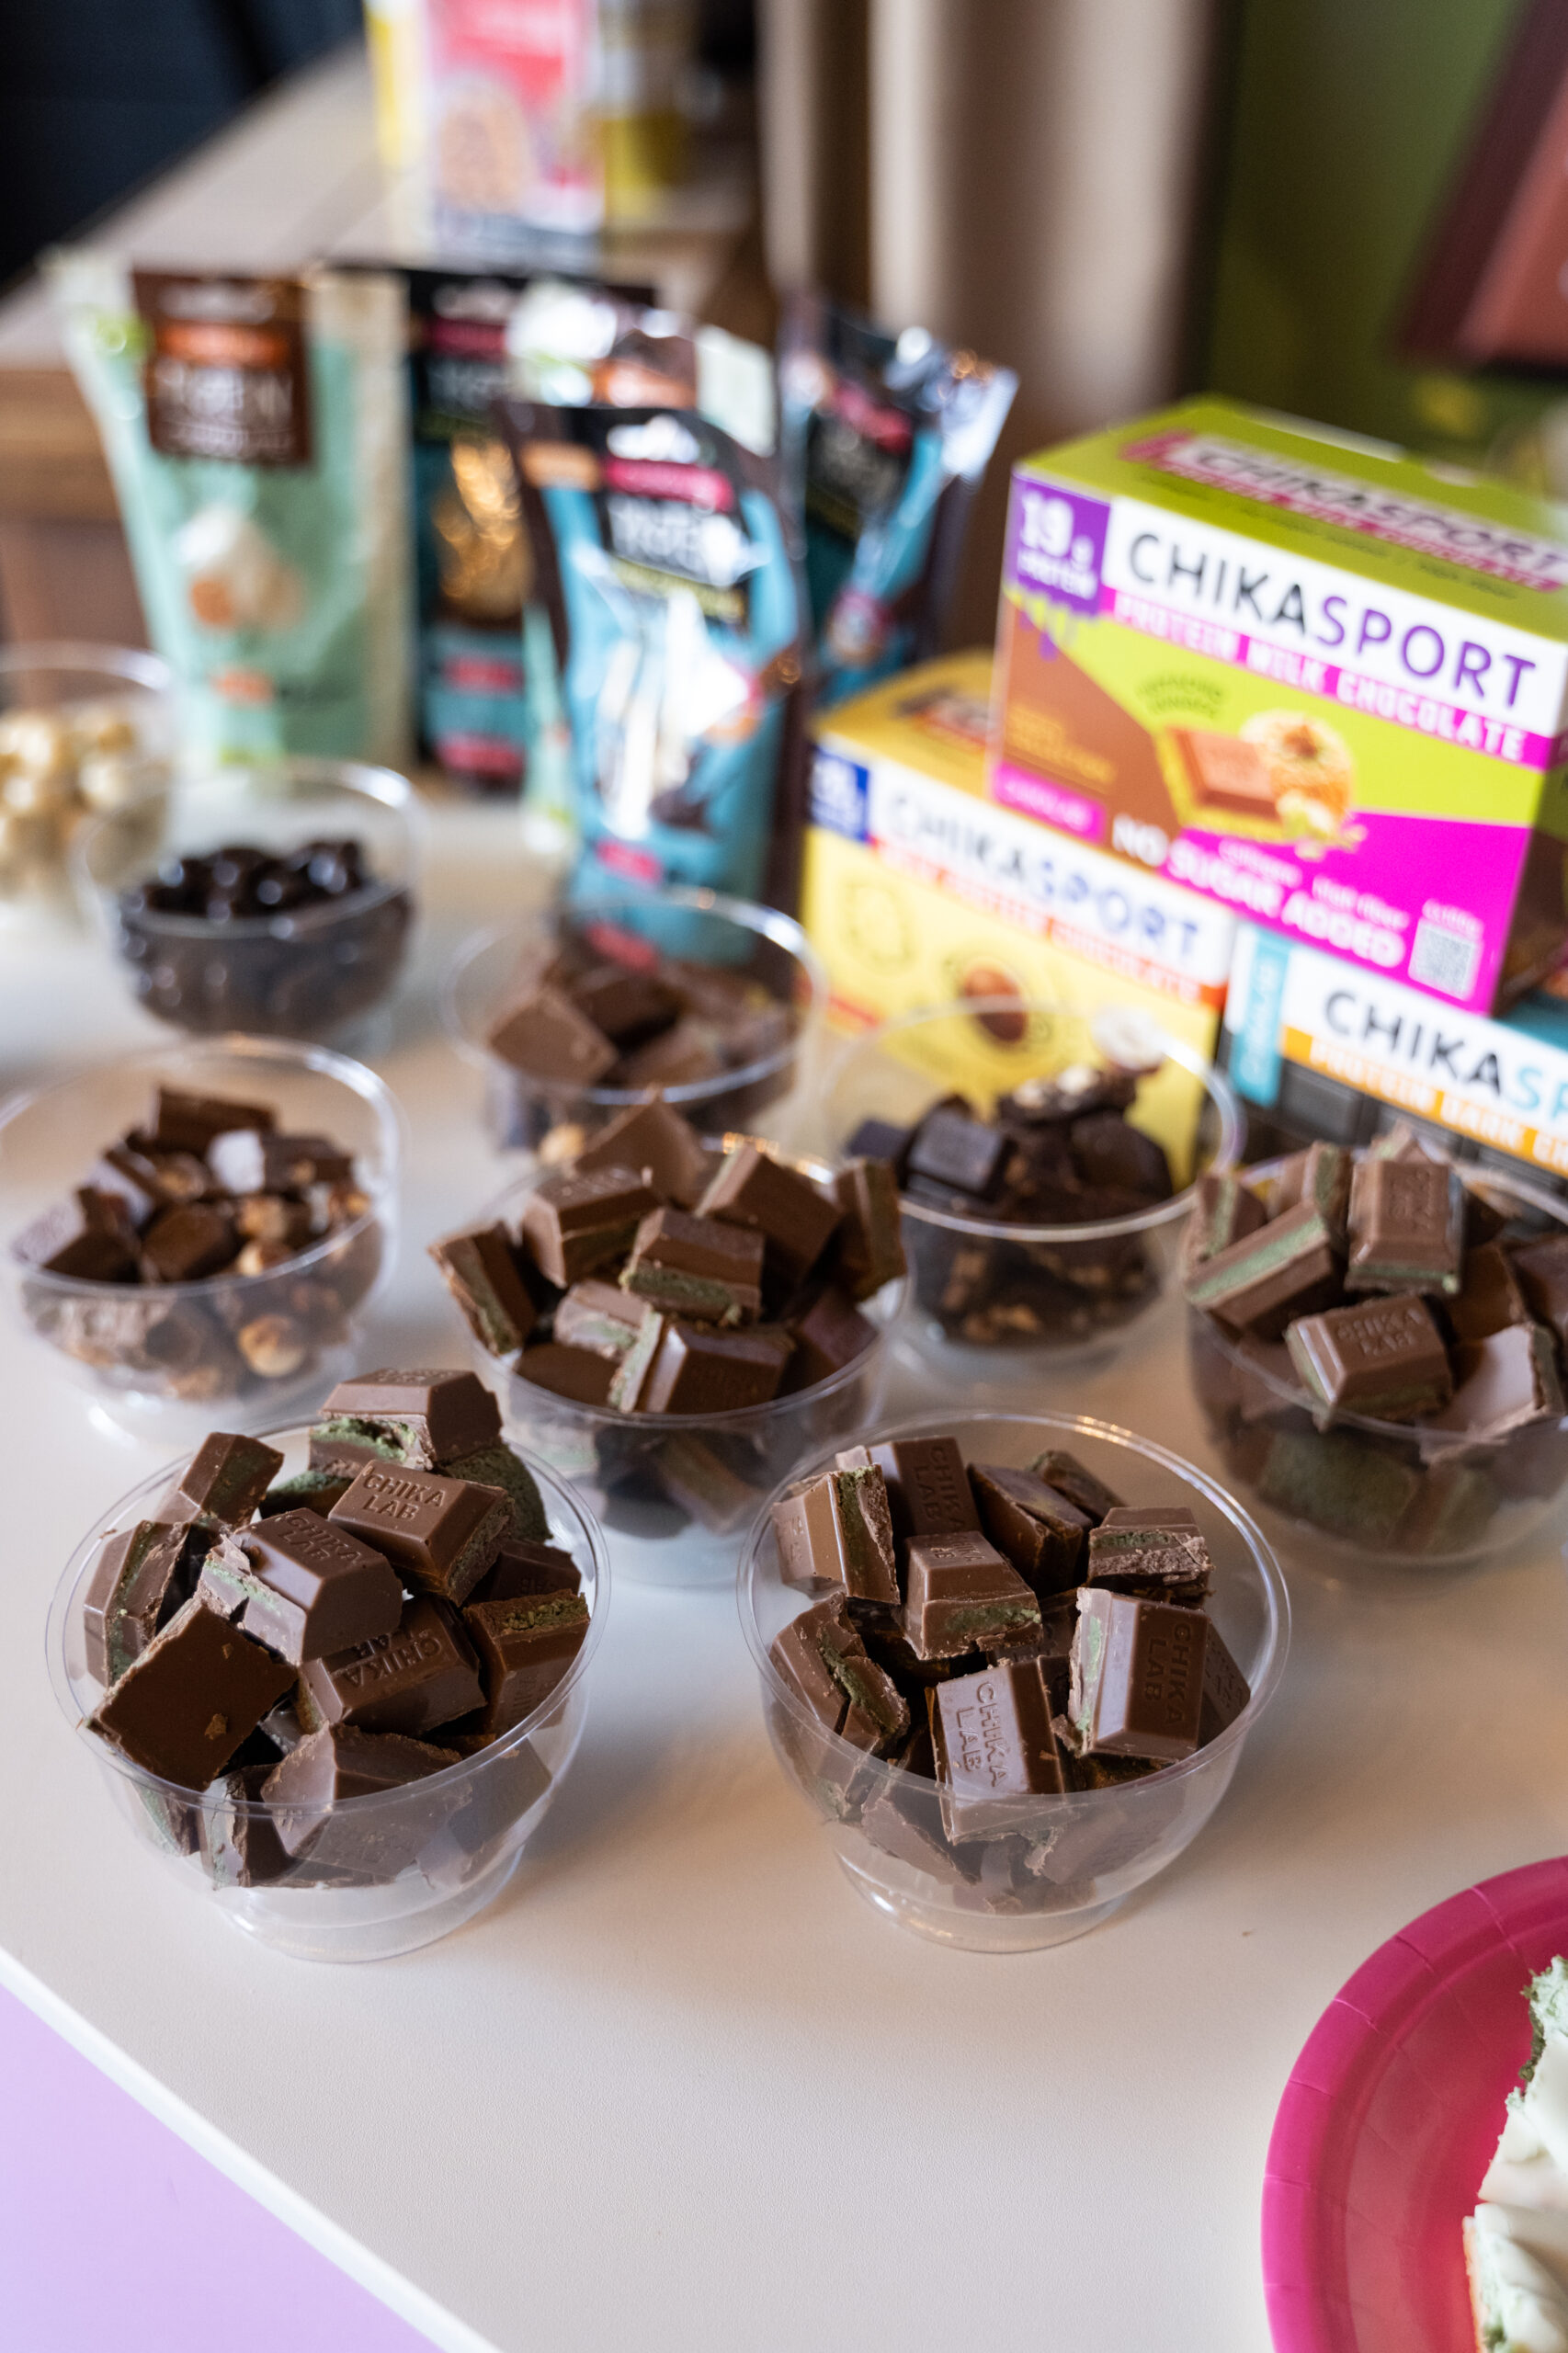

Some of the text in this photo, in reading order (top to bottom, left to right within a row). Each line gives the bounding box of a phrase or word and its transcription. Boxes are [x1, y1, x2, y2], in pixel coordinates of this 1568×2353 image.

[1130, 533, 1537, 709] CHIKASPORT
[1113, 594, 1526, 764] PROTEIN MILK CHOCOLATE
[1112, 813, 1405, 968] NO SUGAR ADDED
[362, 1473, 447, 1507] CHIKA
[362, 1495, 420, 1519] LAB
[915, 1465, 938, 1522] LAB
[930, 1445, 965, 1531] CHIKA
[278, 1531, 331, 1559] LAB
[286, 1517, 361, 1563] CHIKA
[343, 1636, 443, 1688] CHIKA
[1146, 1636, 1165, 1701] LAB
[1168, 1621, 1194, 1726] CHIKA
[956, 1706, 980, 1773] LAB
[976, 1682, 1009, 1788] CHIKA
